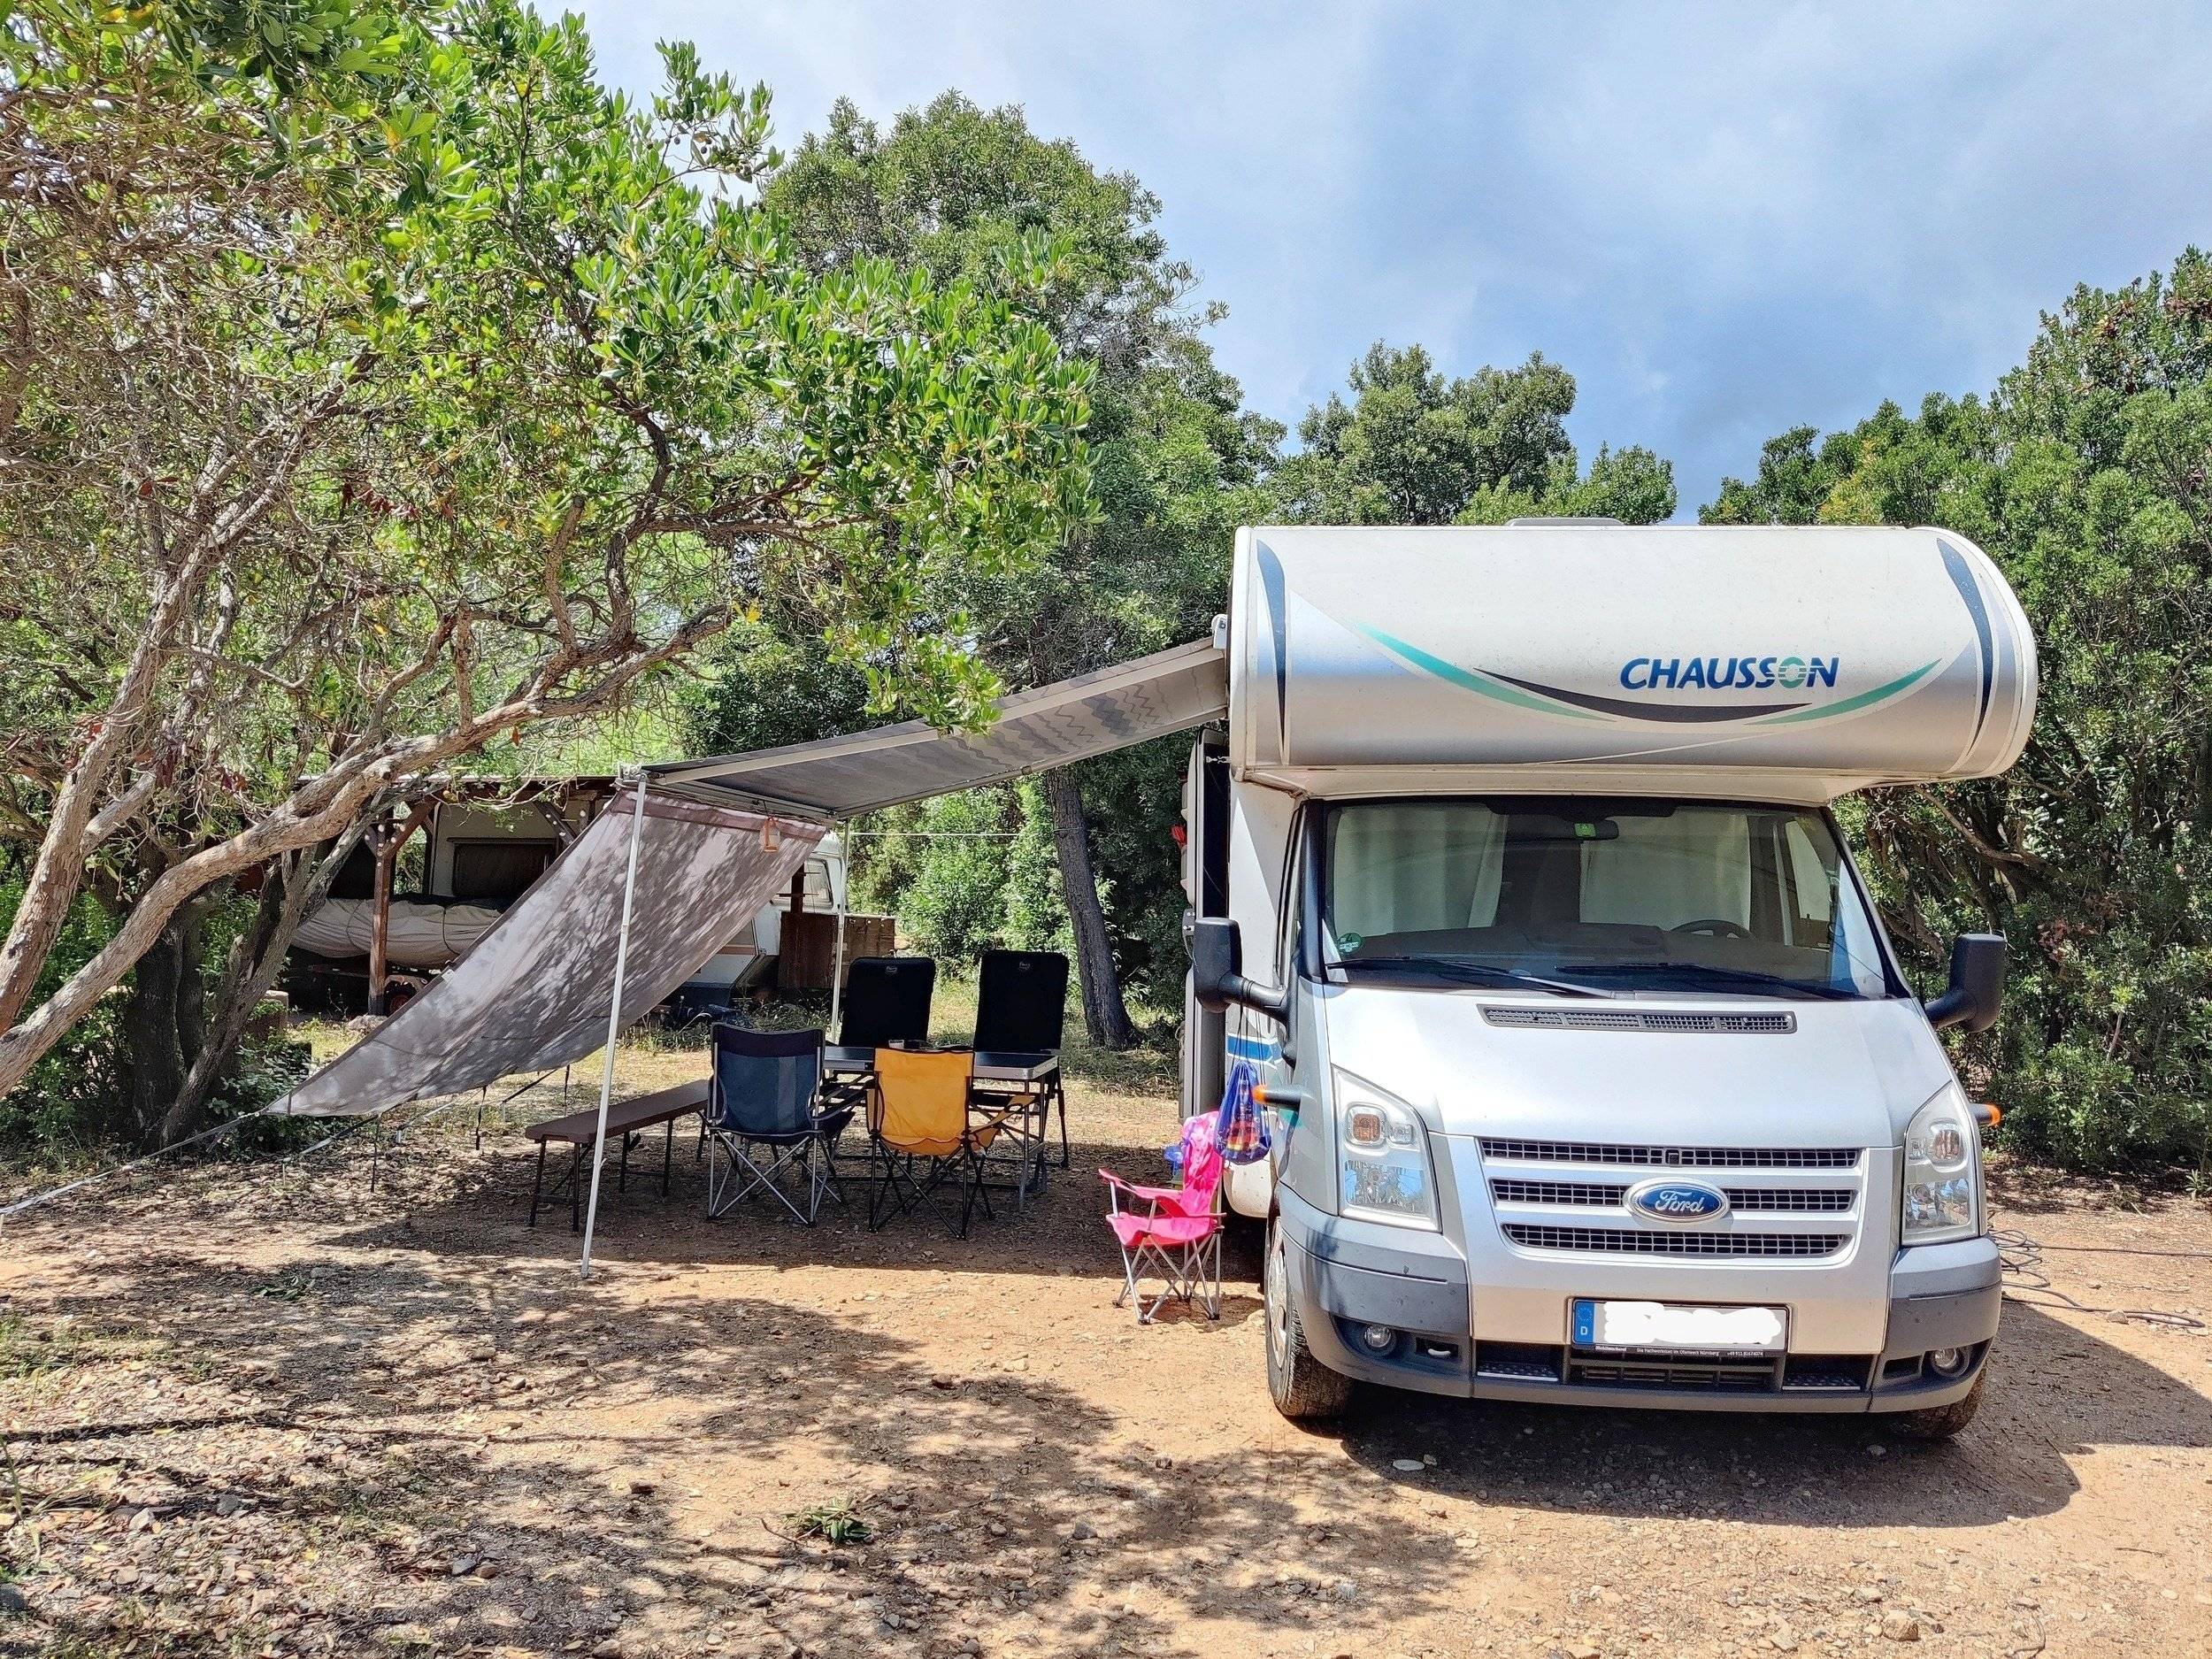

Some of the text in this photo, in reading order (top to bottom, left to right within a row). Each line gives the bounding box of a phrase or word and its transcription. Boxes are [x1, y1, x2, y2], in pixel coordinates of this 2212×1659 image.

[1620, 656, 1839, 690] CHAUSSON
[1655, 1190, 1704, 1212] Ford
[1580, 1325, 1588, 1336] D
